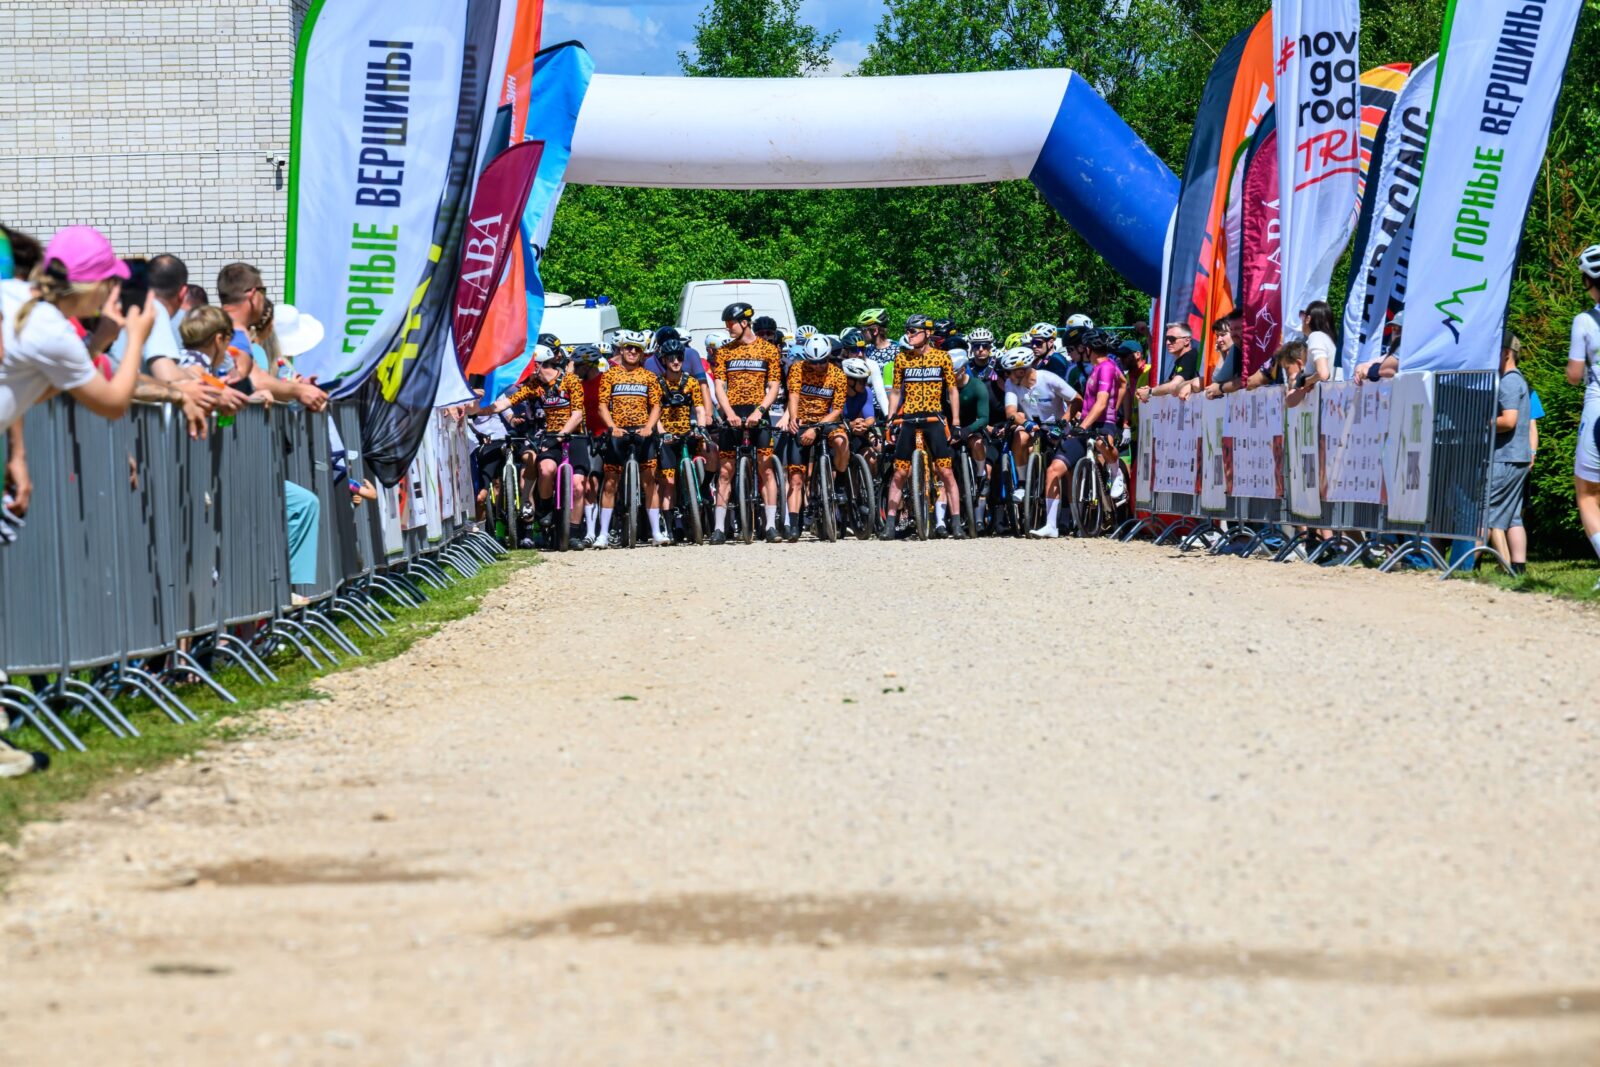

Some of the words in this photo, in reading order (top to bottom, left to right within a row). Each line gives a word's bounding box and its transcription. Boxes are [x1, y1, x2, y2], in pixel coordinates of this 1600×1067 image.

[1299, 83, 1356, 128] rod
[1310, 59, 1356, 97] go
[355, 40, 414, 208] ВЕРШИНЫ
[1451, 145, 1504, 262] ГОРНЫЕ
